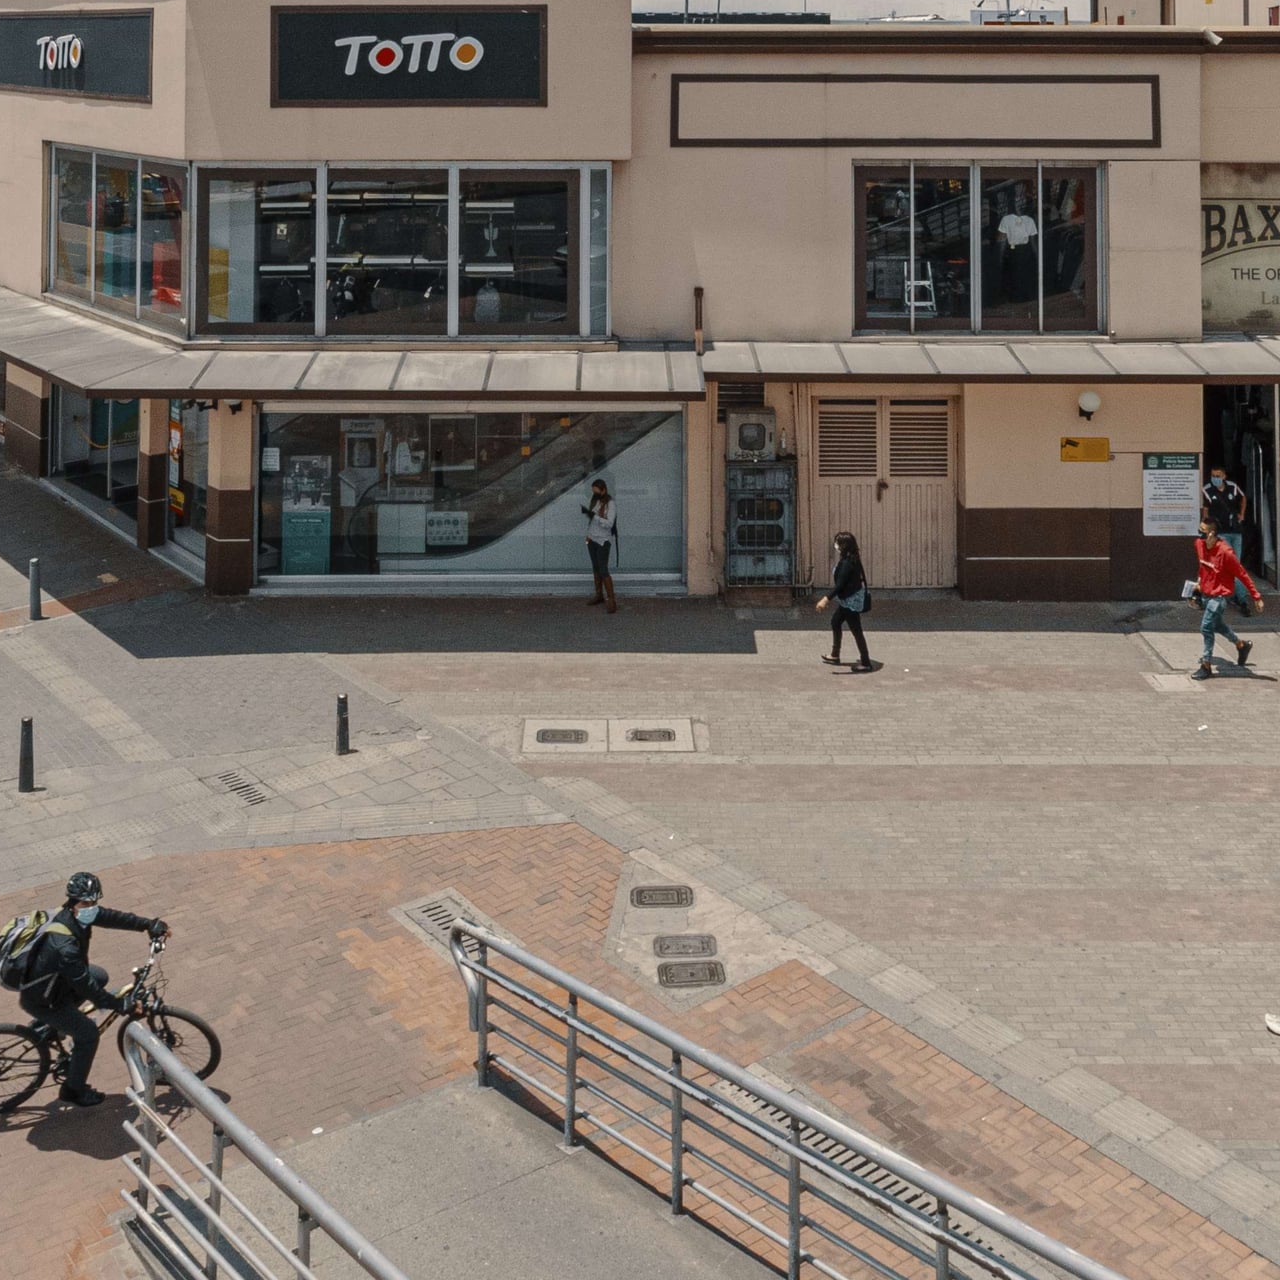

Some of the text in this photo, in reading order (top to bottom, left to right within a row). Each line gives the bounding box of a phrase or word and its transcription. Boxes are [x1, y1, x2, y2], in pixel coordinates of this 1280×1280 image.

[36, 34, 83, 70] TOTTO
[334, 33, 484, 75] TOTTO
[1231, 268, 1261, 281] THE
[1261, 291, 1279, 306] La
